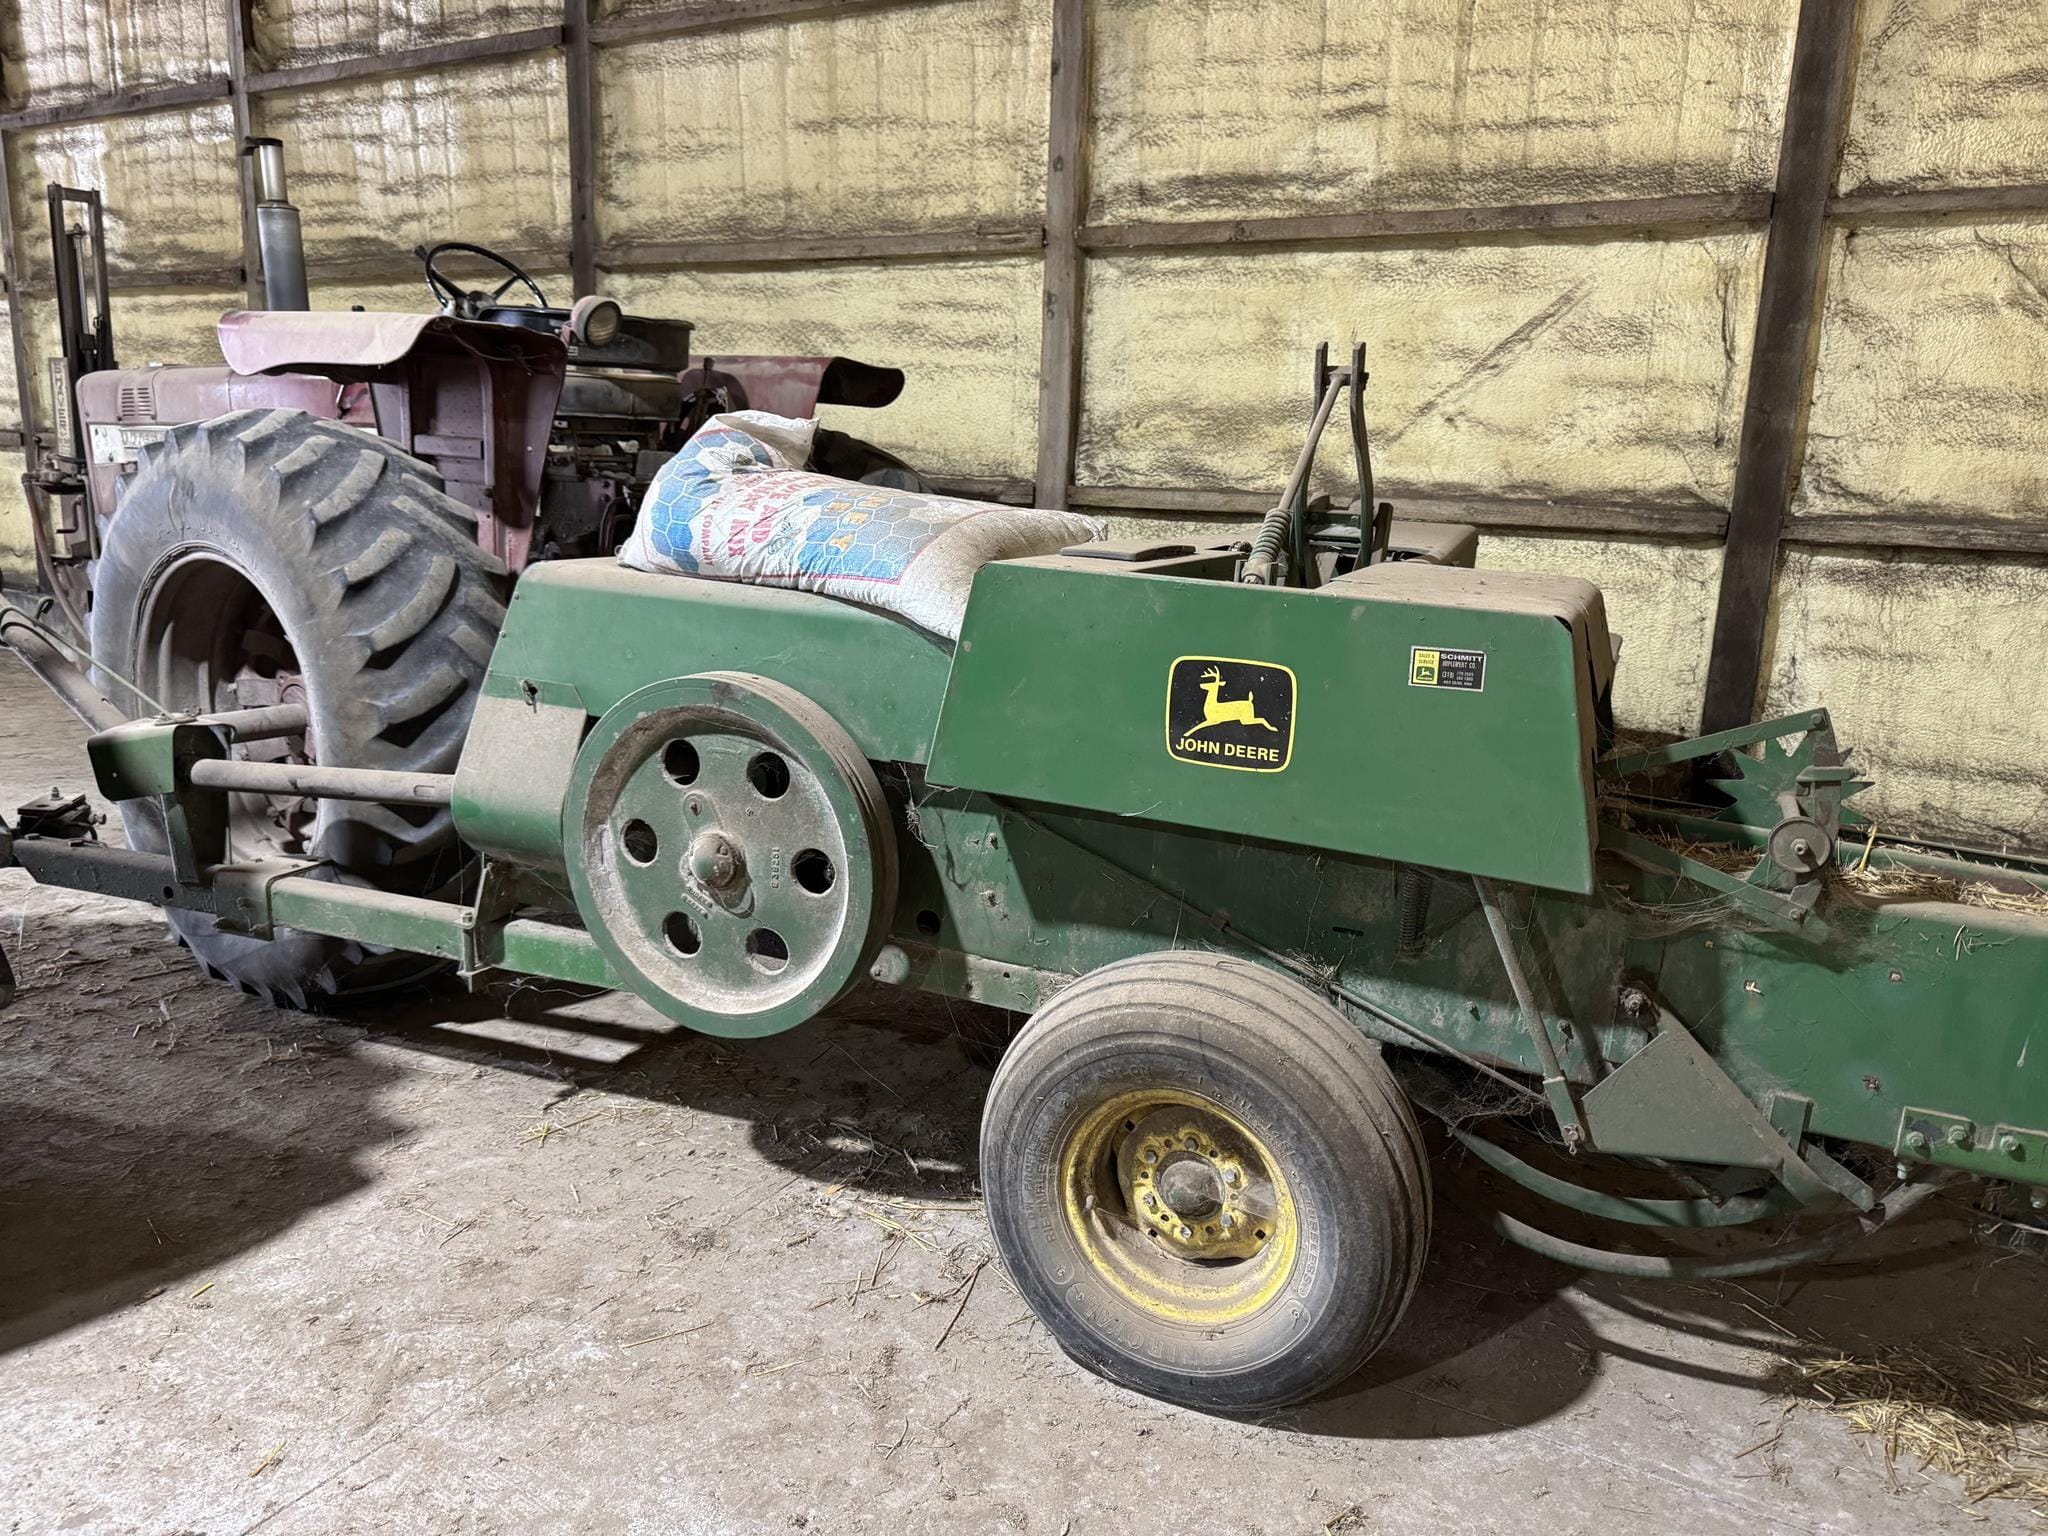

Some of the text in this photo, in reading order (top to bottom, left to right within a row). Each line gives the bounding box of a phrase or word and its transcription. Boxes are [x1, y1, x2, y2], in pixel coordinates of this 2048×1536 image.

[701, 514, 714, 567] COMPANY
[752, 505, 778, 544] AND
[1440, 653, 1483, 663] SCHMITT
[1175, 737, 1280, 762] JOHN DEERE
[1083, 1295, 1222, 1367] UNIROYAL
